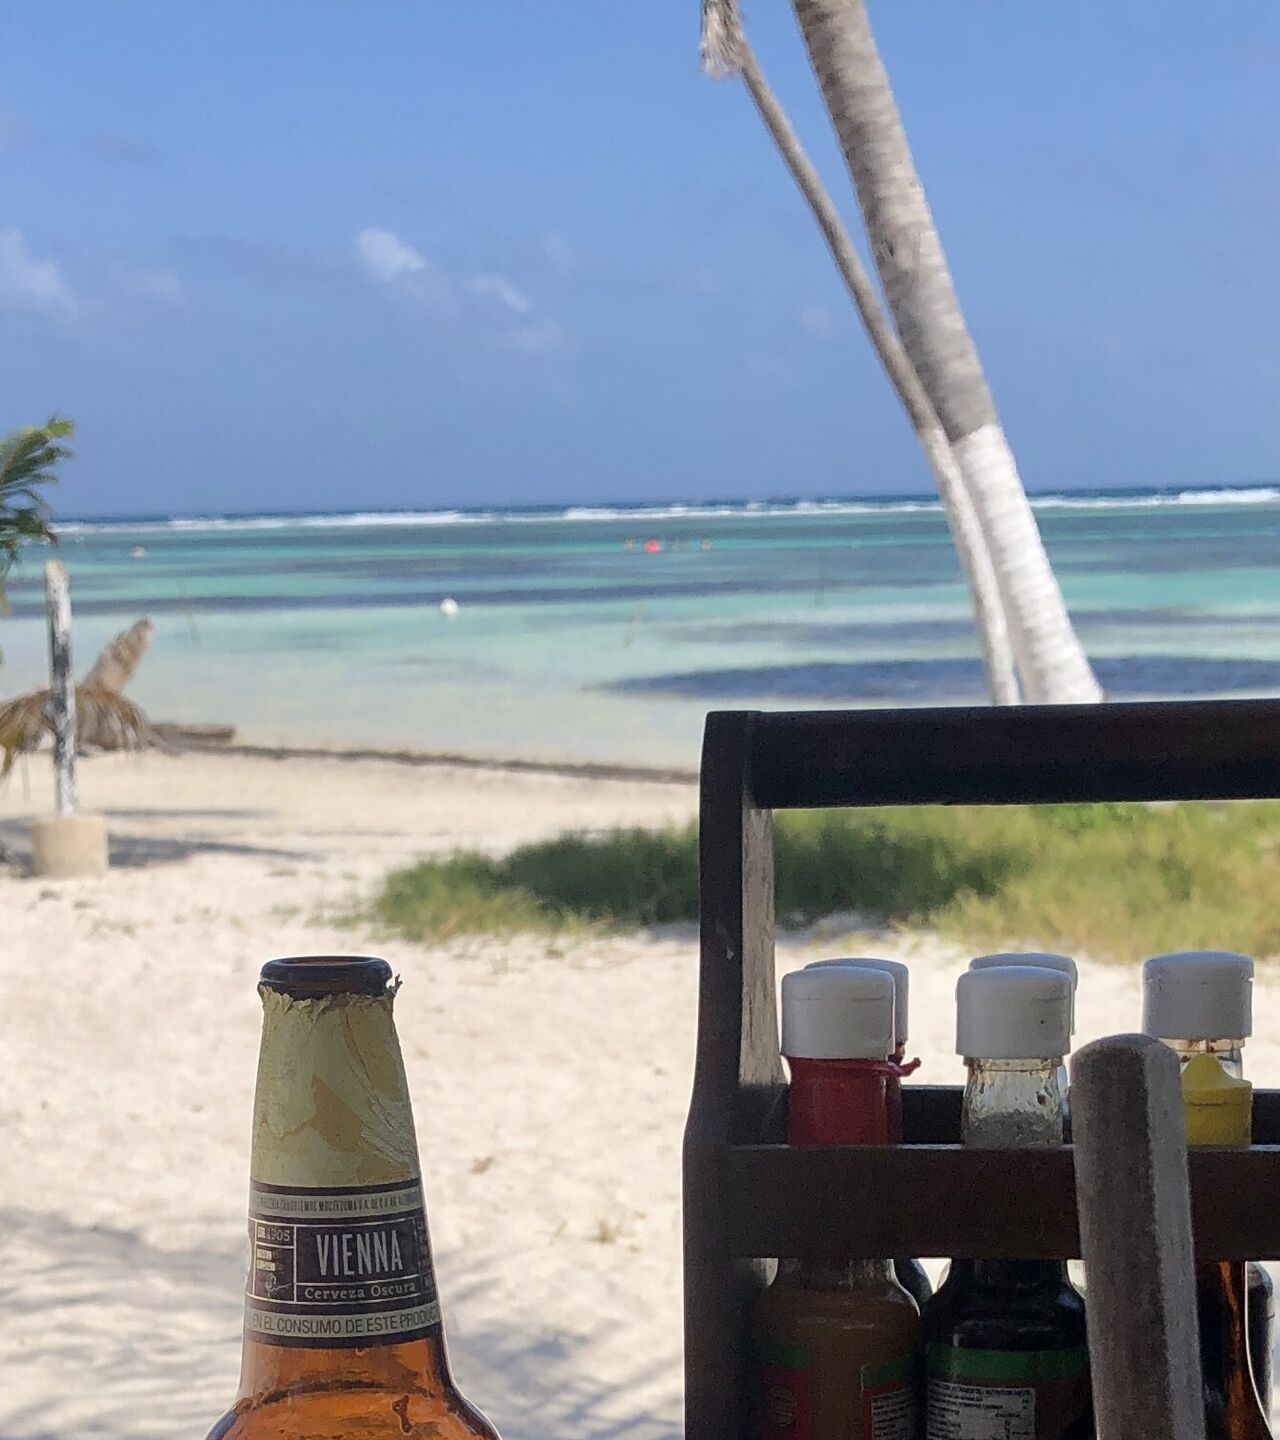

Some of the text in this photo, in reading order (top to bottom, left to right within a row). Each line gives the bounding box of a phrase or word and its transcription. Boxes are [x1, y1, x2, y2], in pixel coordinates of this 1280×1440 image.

[266, 1227, 290, 1242] 1905
[316, 1229, 403, 1276] VIENNA
[304, 1281, 417, 1300] Cerveza Oscura
[277, 1319, 341, 1334] CONSUMO
[345, 1319, 363, 1334] DE
[366, 1317, 397, 1332] ESTE
